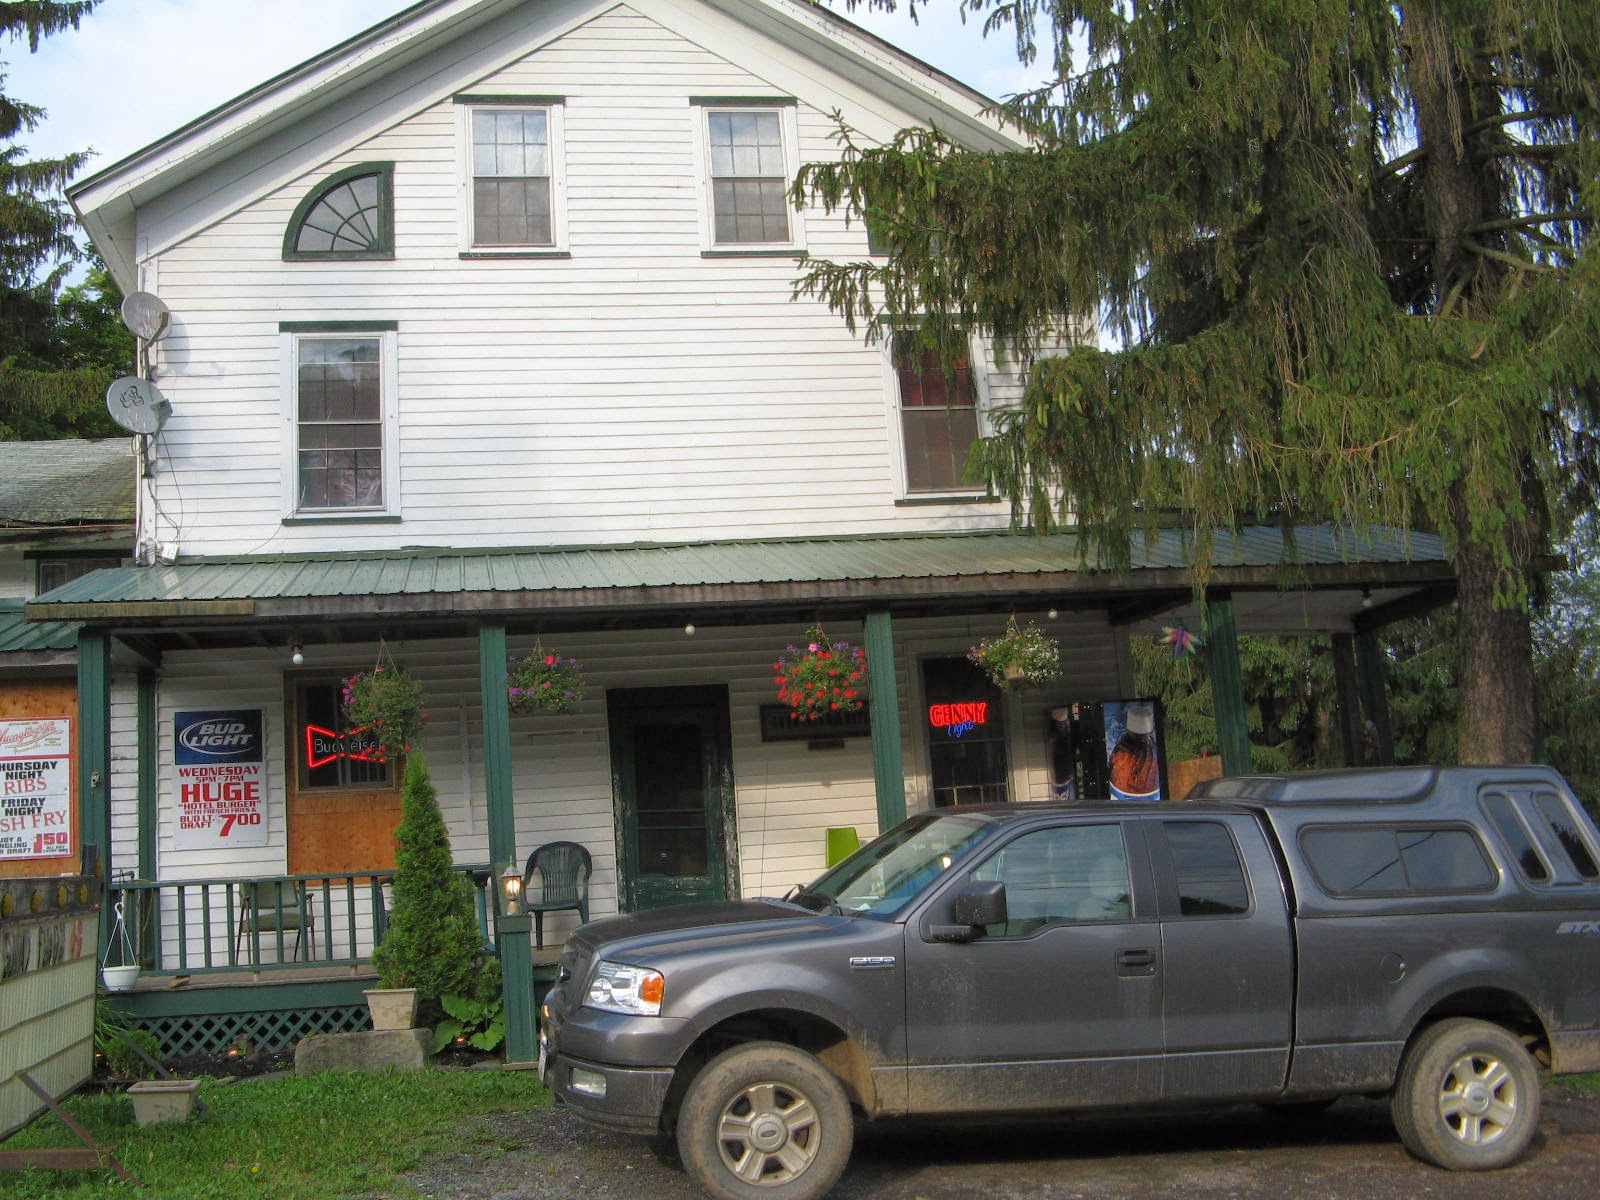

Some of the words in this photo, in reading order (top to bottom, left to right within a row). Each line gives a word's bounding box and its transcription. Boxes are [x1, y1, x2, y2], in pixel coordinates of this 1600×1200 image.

[929, 701, 987, 727] GENNY
[200, 723, 246, 735] BUD
[190, 734, 253, 747] LIGHT
[5, 770, 43, 780] NIGHT
[178, 766, 260, 777] WEDNESDAY
[4, 776, 47, 795] RIBS
[181, 781, 260, 803] HUGE
[1, 797, 46, 808] FRIDAY
[5, 806, 43, 816] NIGHT
[32, 810, 67, 828] FRY
[180, 815, 200, 823] BUD
[202, 814, 215, 822] LT.
[180, 821, 212, 829] DRAFT
